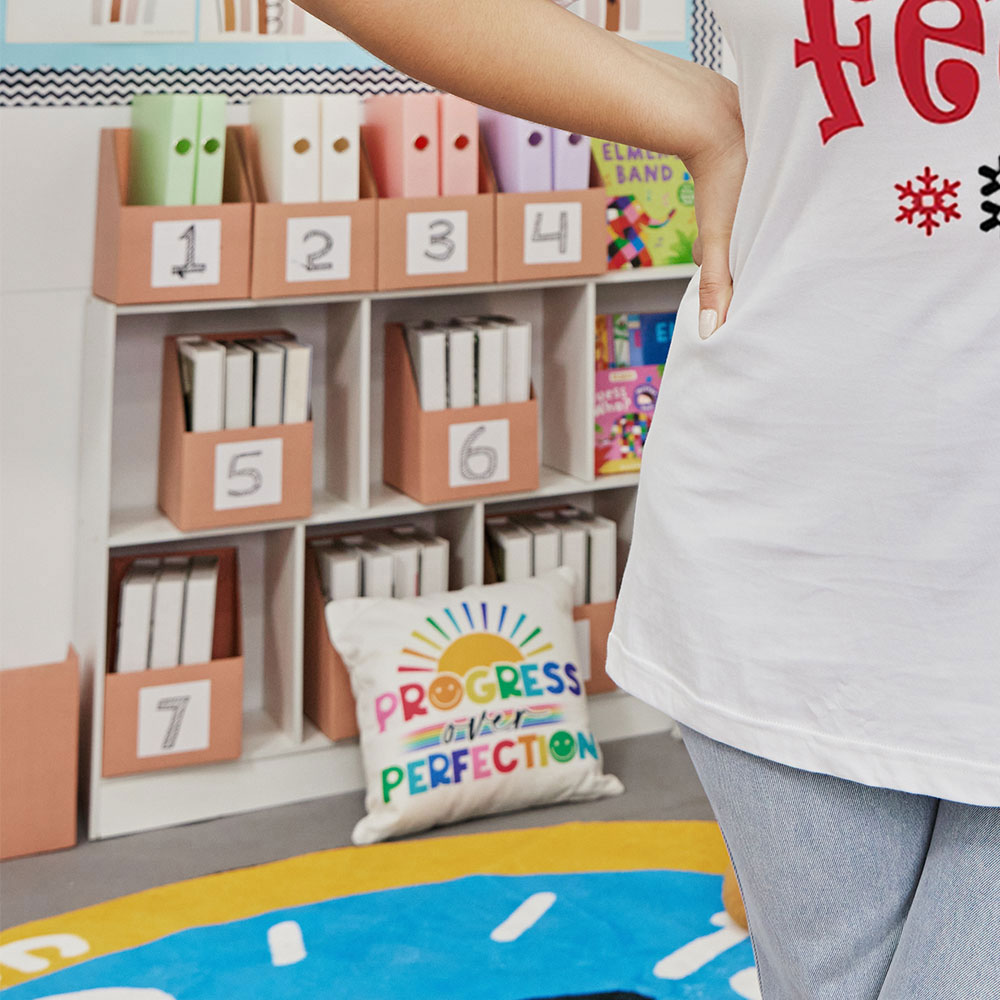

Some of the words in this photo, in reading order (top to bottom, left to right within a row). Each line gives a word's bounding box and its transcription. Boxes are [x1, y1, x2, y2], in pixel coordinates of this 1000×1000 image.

[616, 164, 673, 184] BAND
[170, 223, 207, 280] 1
[302, 229, 334, 273] 2
[423, 218, 456, 263] 3
[531, 210, 568, 255] 4
[226, 449, 264, 498] 5
[459, 424, 498, 482] 6
[374, 661, 582, 734] PROGRESS
[157, 694, 192, 751] 7
[443, 707, 528, 744] over
[380, 729, 600, 804] PERFECTION
